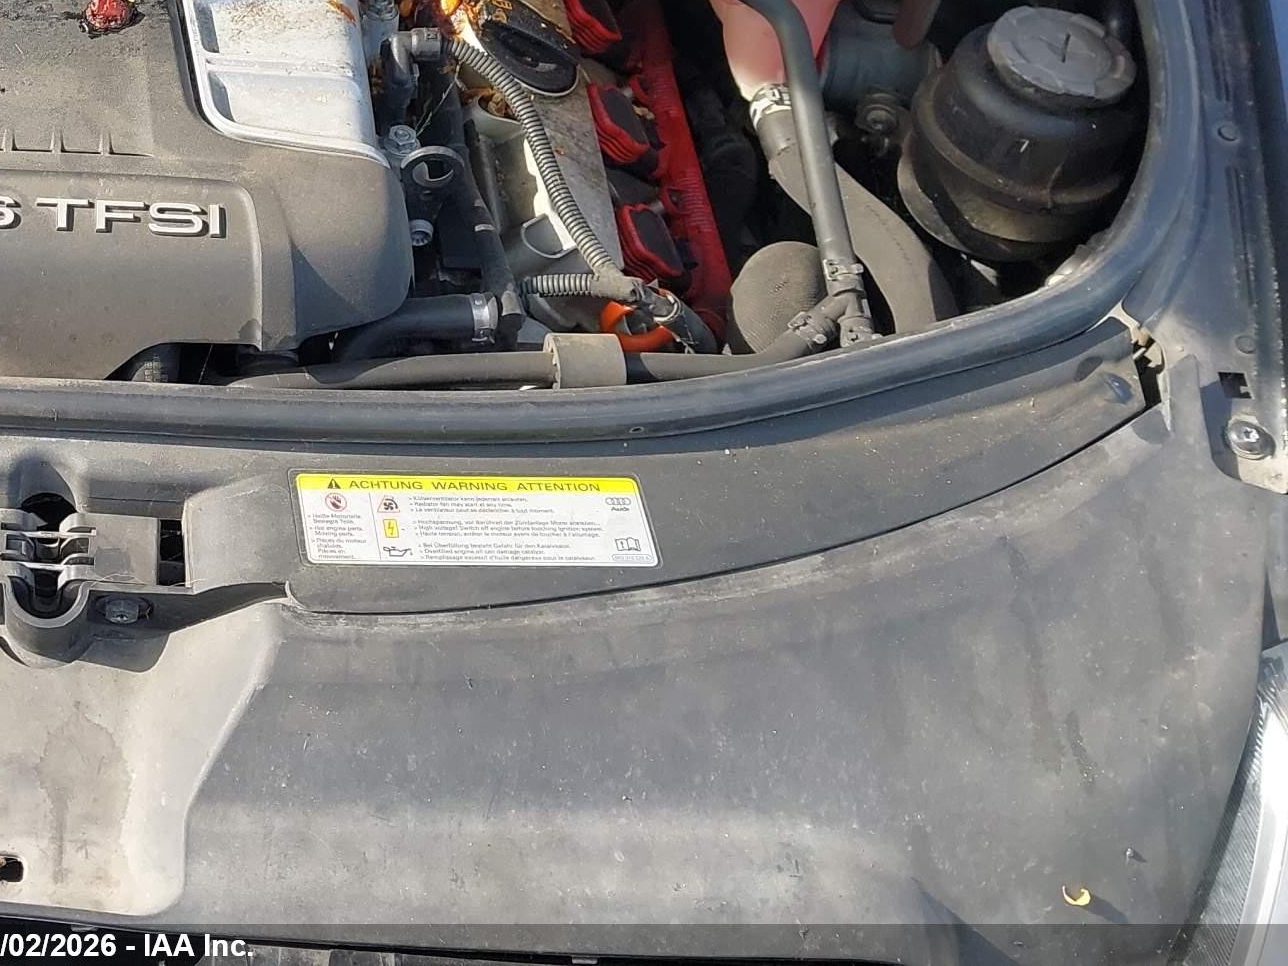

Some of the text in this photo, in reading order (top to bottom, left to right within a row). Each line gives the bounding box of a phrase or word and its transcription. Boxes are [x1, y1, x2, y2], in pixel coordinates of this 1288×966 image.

[37, 196, 226, 238] TFSI
[349, 480, 601, 492] ACHTUNG WARNING ATTENTION
